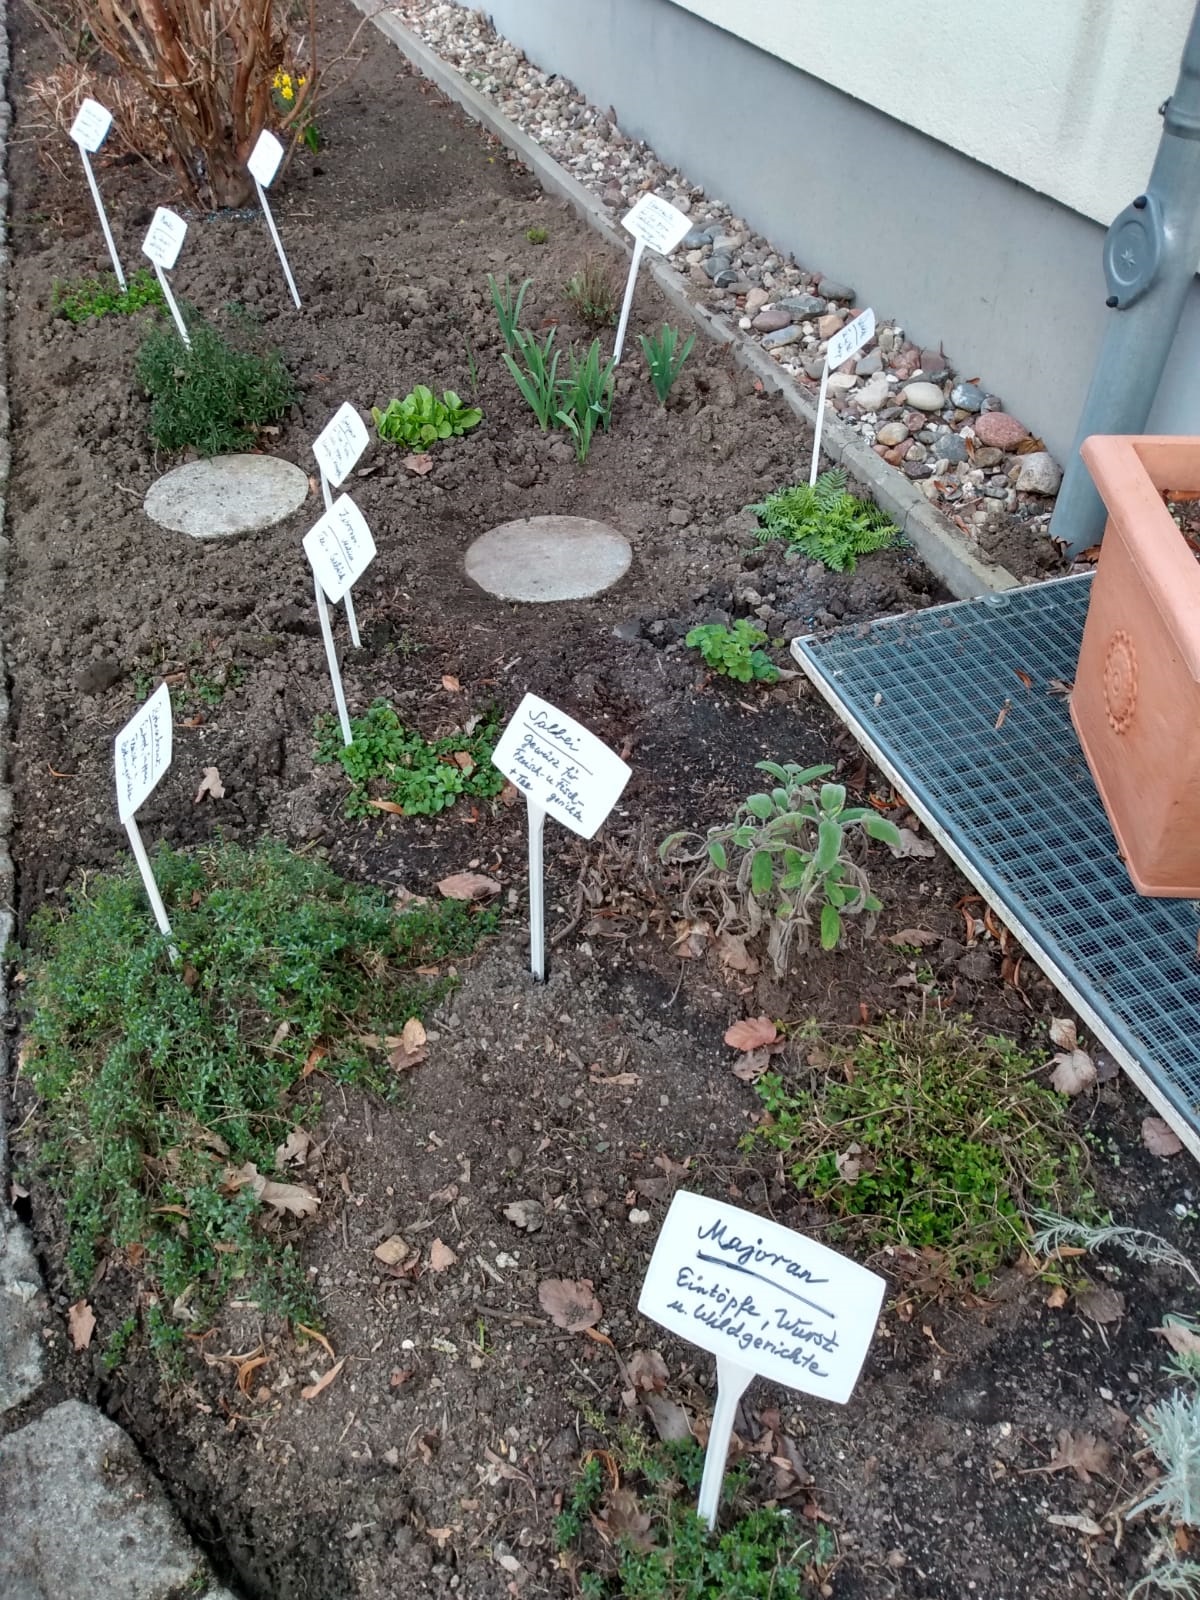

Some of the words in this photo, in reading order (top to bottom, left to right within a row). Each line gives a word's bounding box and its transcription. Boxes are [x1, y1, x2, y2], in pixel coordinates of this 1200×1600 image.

[529, 710, 581, 751] Salbei
[516, 774, 533, 791] Tee
[561, 766, 579, 780] für
[698, 1218, 830, 1284] Majoran
[693, 1304, 829, 1378] Wildgerichte
[775, 1308, 840, 1354] Wurst
